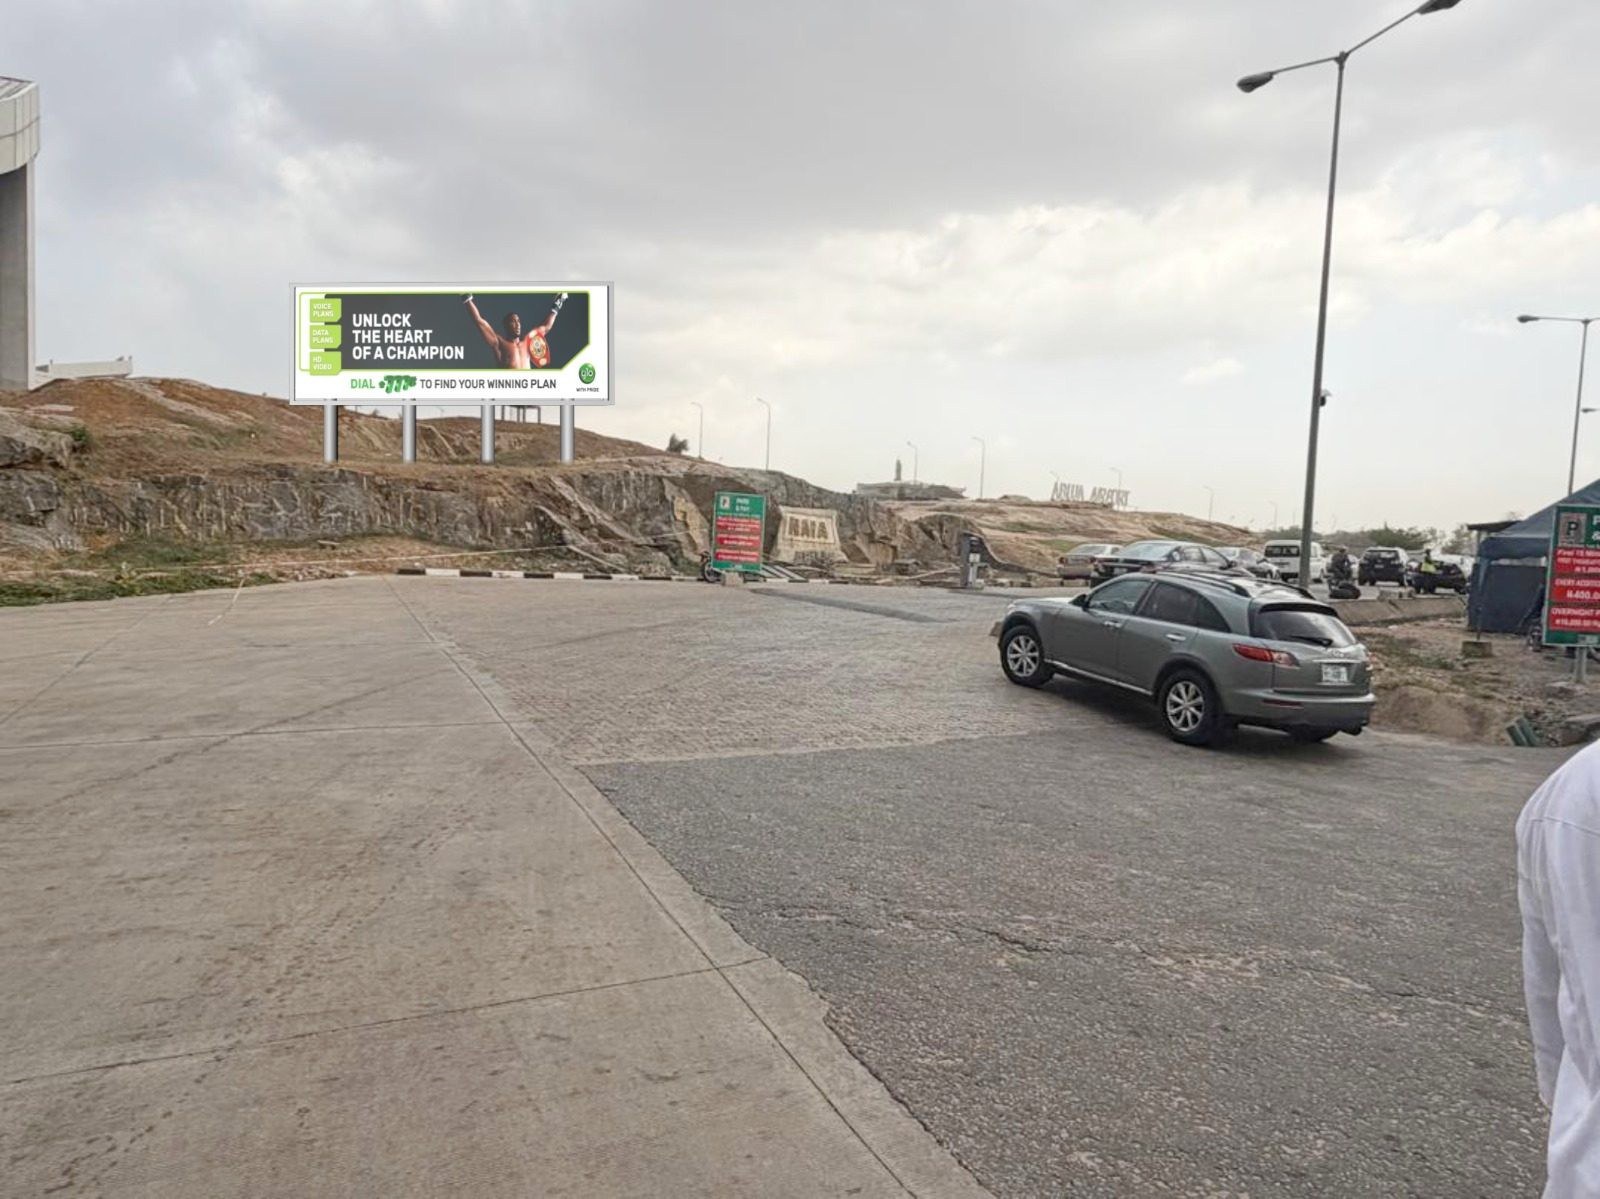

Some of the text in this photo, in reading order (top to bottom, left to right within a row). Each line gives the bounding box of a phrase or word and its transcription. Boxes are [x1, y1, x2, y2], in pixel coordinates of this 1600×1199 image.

[352, 313, 411, 327] UNLOCK
[352, 329, 433, 343] THE HEART
[352, 346, 465, 360] OF A CHAMPION
[581, 367, 594, 380] glo
[350, 378, 375, 389] DIAL
[420, 379, 432, 389] TO
[434, 379, 457, 389] FIND
[458, 379, 485, 389] YOUR
[487, 379, 529, 389] WINNING
[530, 379, 557, 389] PLAN
[1551, 607, 1593, 616] OVERNIGHT
